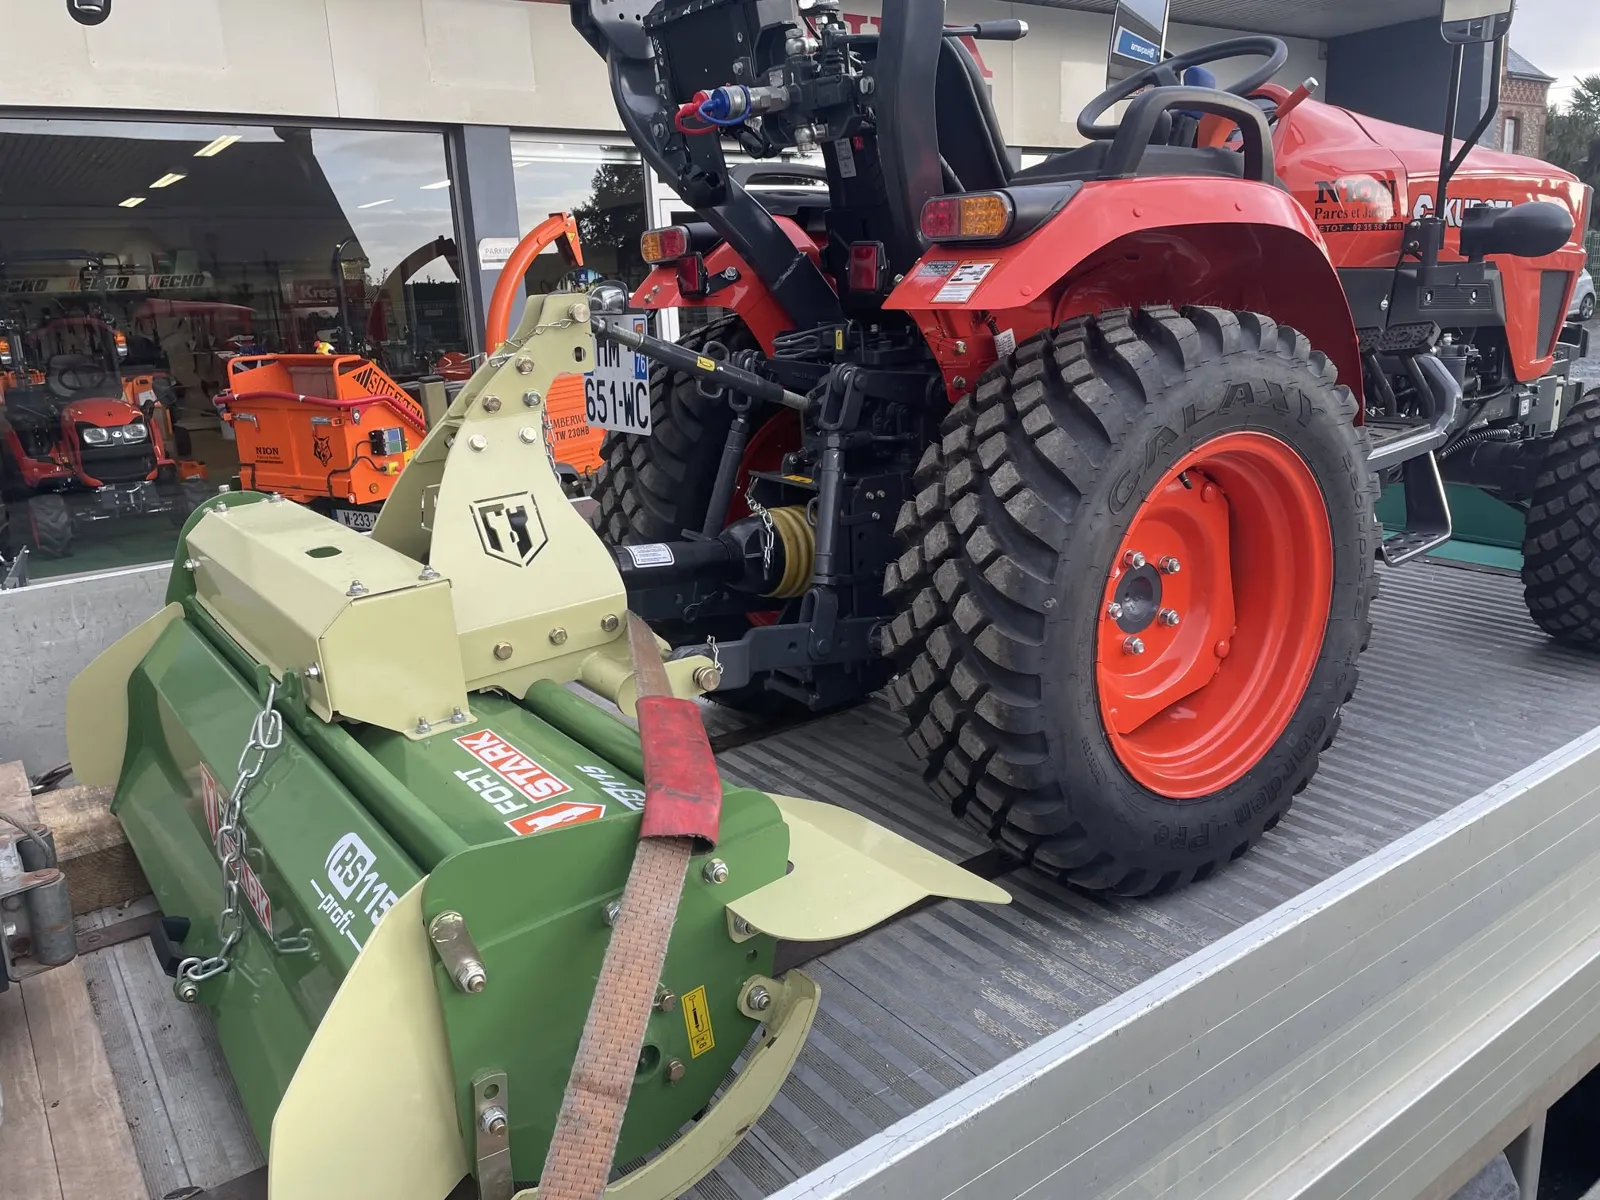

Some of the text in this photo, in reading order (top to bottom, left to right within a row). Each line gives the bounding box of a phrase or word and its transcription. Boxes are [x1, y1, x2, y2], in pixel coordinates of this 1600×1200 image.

[1315, 181, 1396, 204] NION
[1314, 207, 1348, 220] Parcs
[1351, 208, 1360, 218] et
[160, 275, 204, 288] ECHO
[300, 285, 338, 299] Kres
[635, 353, 646, 373] 76
[585, 378, 649, 429] 651-WC
[555, 425, 590, 441] TW 230HB
[255, 446, 279, 455] NION
[1108, 378, 1323, 516] GALAXY
[461, 731, 563, 798] STARK
[453, 767, 528, 815] FORT
[332, 842, 400, 926] RS115
[317, 893, 356, 936] profi
